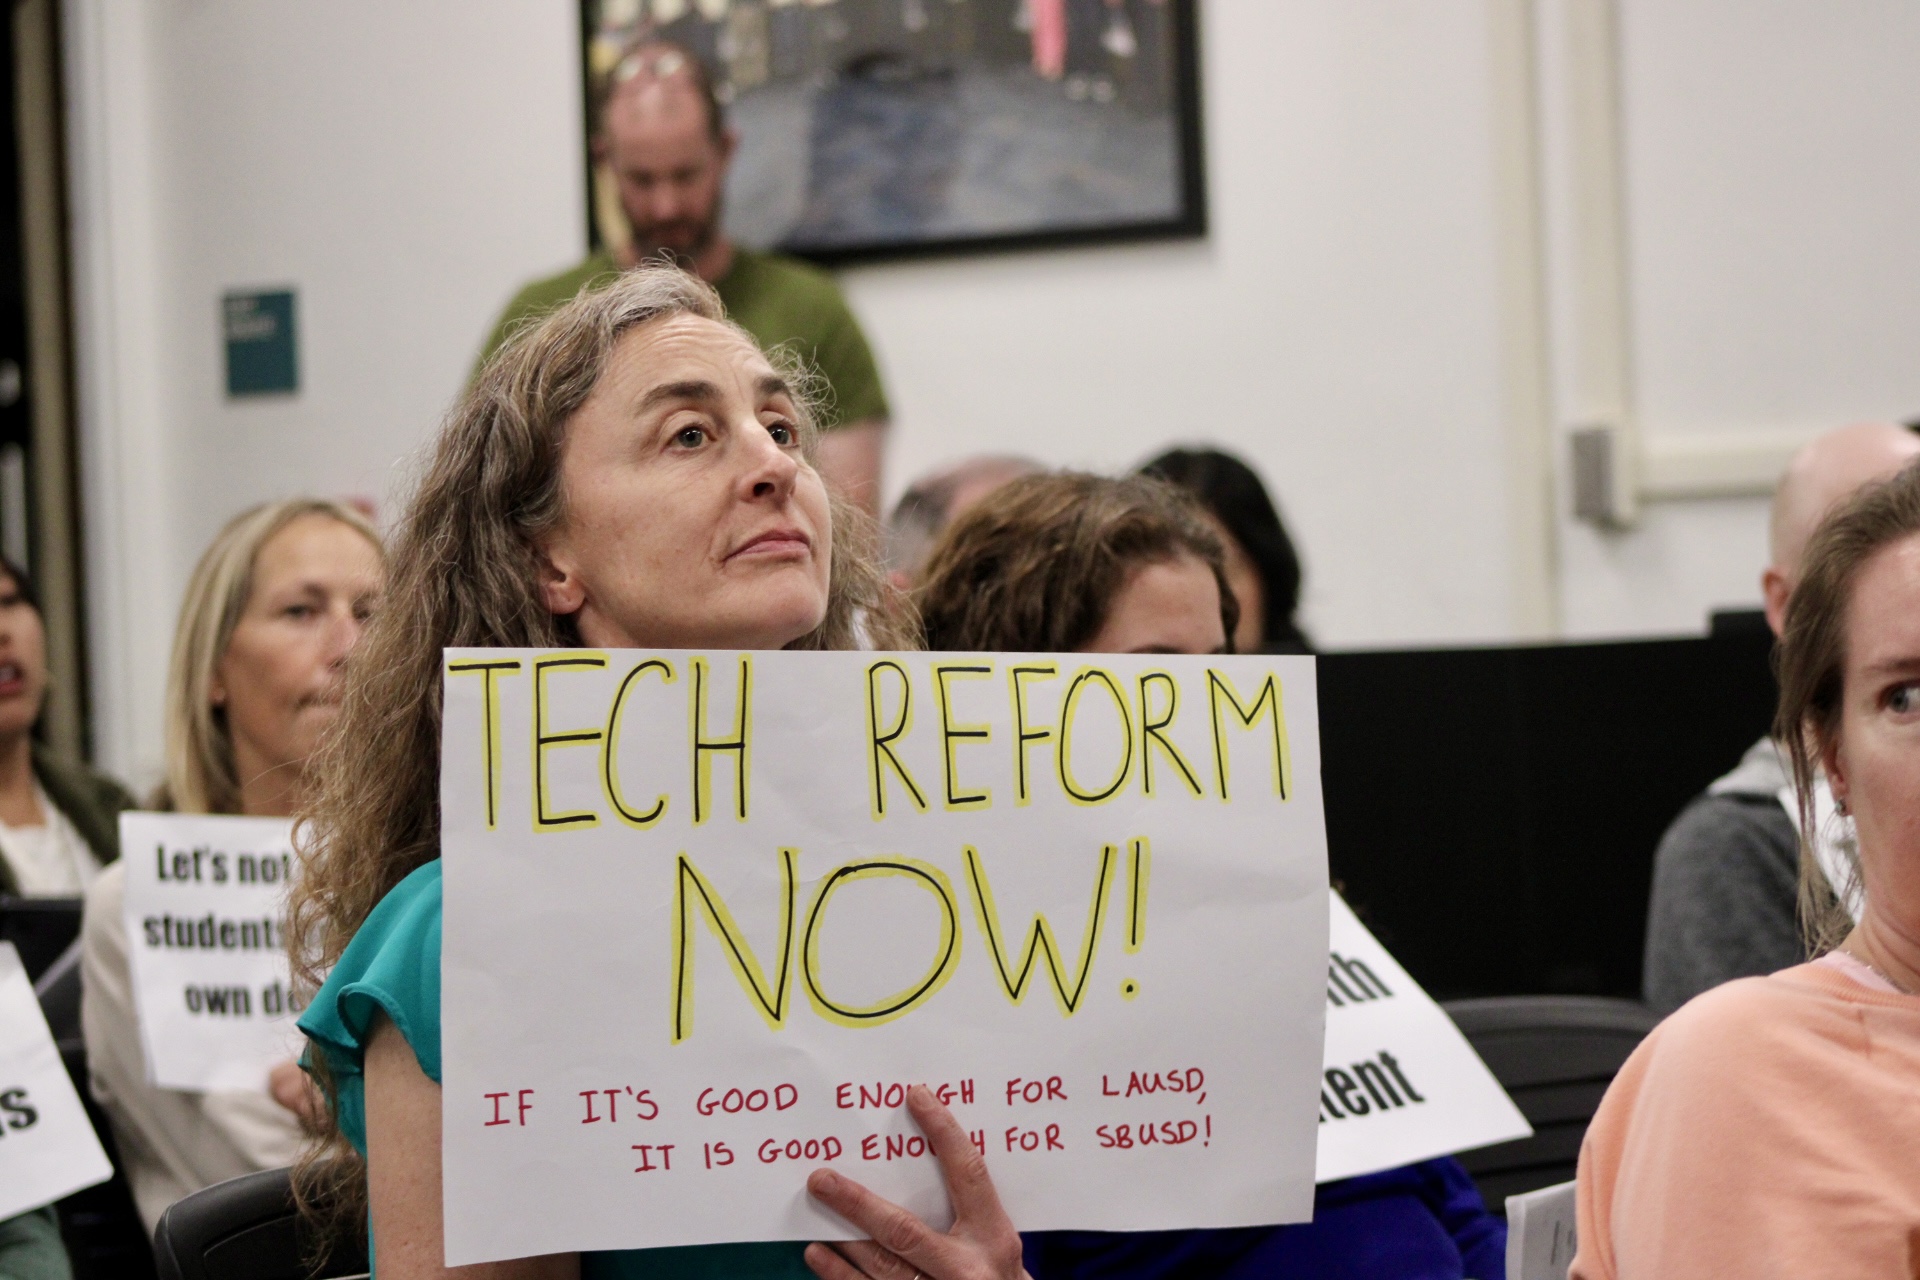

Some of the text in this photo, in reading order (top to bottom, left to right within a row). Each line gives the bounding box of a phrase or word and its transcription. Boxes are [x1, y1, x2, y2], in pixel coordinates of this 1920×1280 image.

[449, 654, 1290, 832] TECH REFORM
[156, 844, 229, 883] Let's
[143, 913, 289, 949] student
[671, 834, 1151, 1045] NOW!
[185, 984, 253, 1015] own
[484, 1067, 1207, 1126] IF IT'S GOOD ENOGH FOR LAUSD,
[631, 1114, 1212, 1173] IT IS GOOD ENOH FOR SBUSD!
